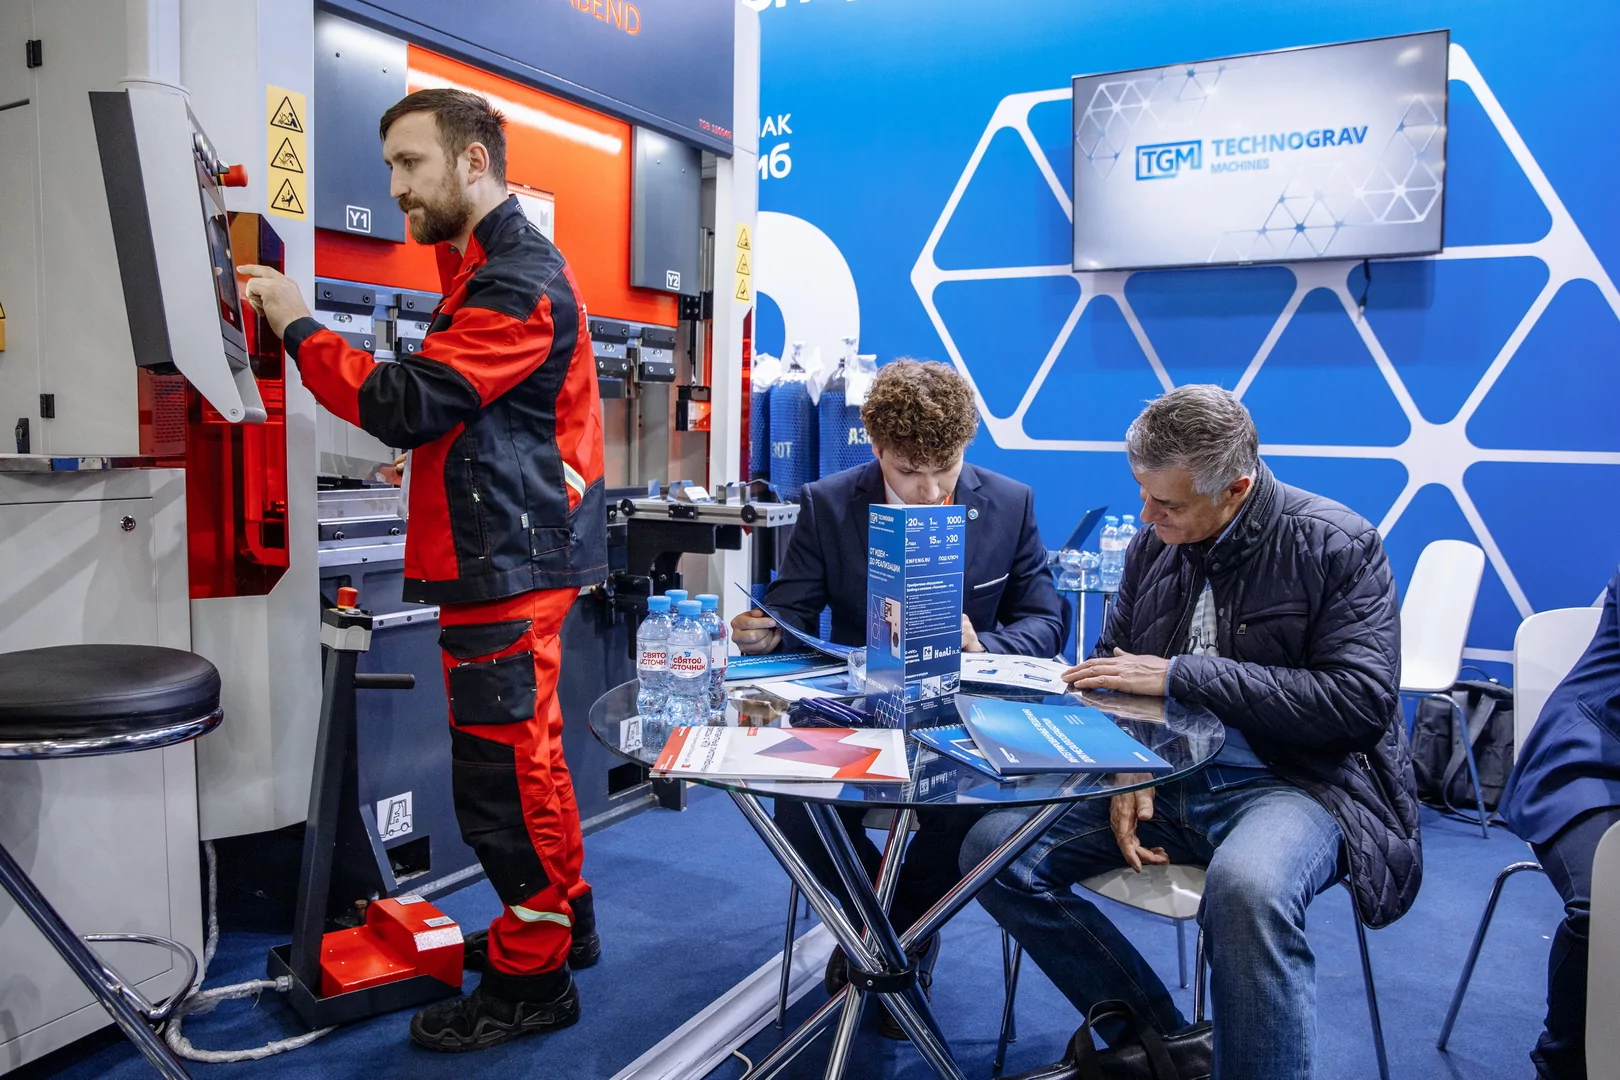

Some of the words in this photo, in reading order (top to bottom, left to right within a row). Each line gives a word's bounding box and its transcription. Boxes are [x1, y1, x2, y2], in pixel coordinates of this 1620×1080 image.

[758, 112, 793, 138] АК
[1211, 125, 1369, 157] TECHNOGRAV
[1141, 148, 1200, 174] TGM
[1210, 158, 1270, 174] MACHINES
[349, 210, 368, 229] Y1
[668, 274, 679, 287] Y2
[847, 427, 873, 445] АЗ
[946, 515, 962, 525] 1000
[640, 658, 667, 666] ИСТОЧН
[642, 651, 667, 659] СВЯТО
[669, 663, 706, 671] ИСТОЧНИК
